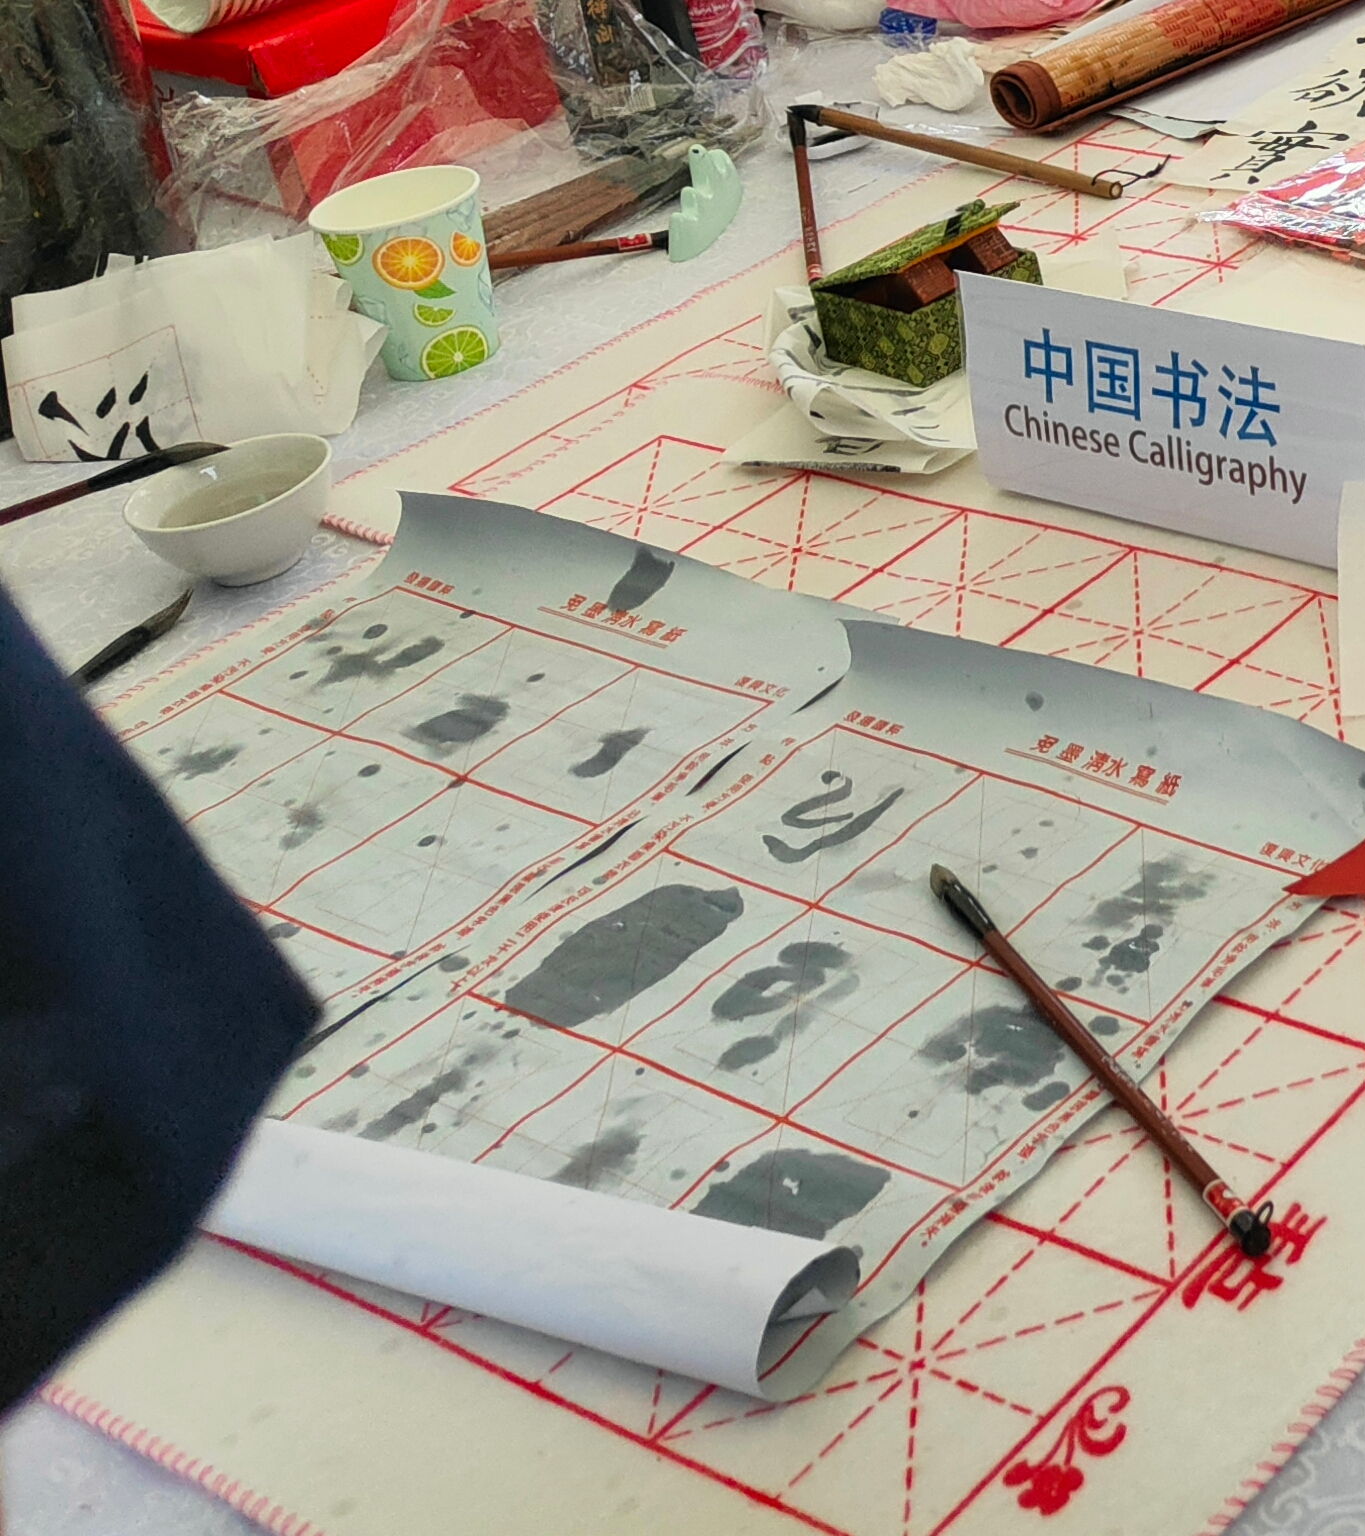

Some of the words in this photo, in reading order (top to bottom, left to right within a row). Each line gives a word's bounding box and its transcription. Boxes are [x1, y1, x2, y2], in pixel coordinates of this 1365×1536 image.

[1022, 327, 1281, 448] 中国书法
[1004, 403, 1121, 459] Chinese
[1128, 429, 1308, 505] Calligraphy
